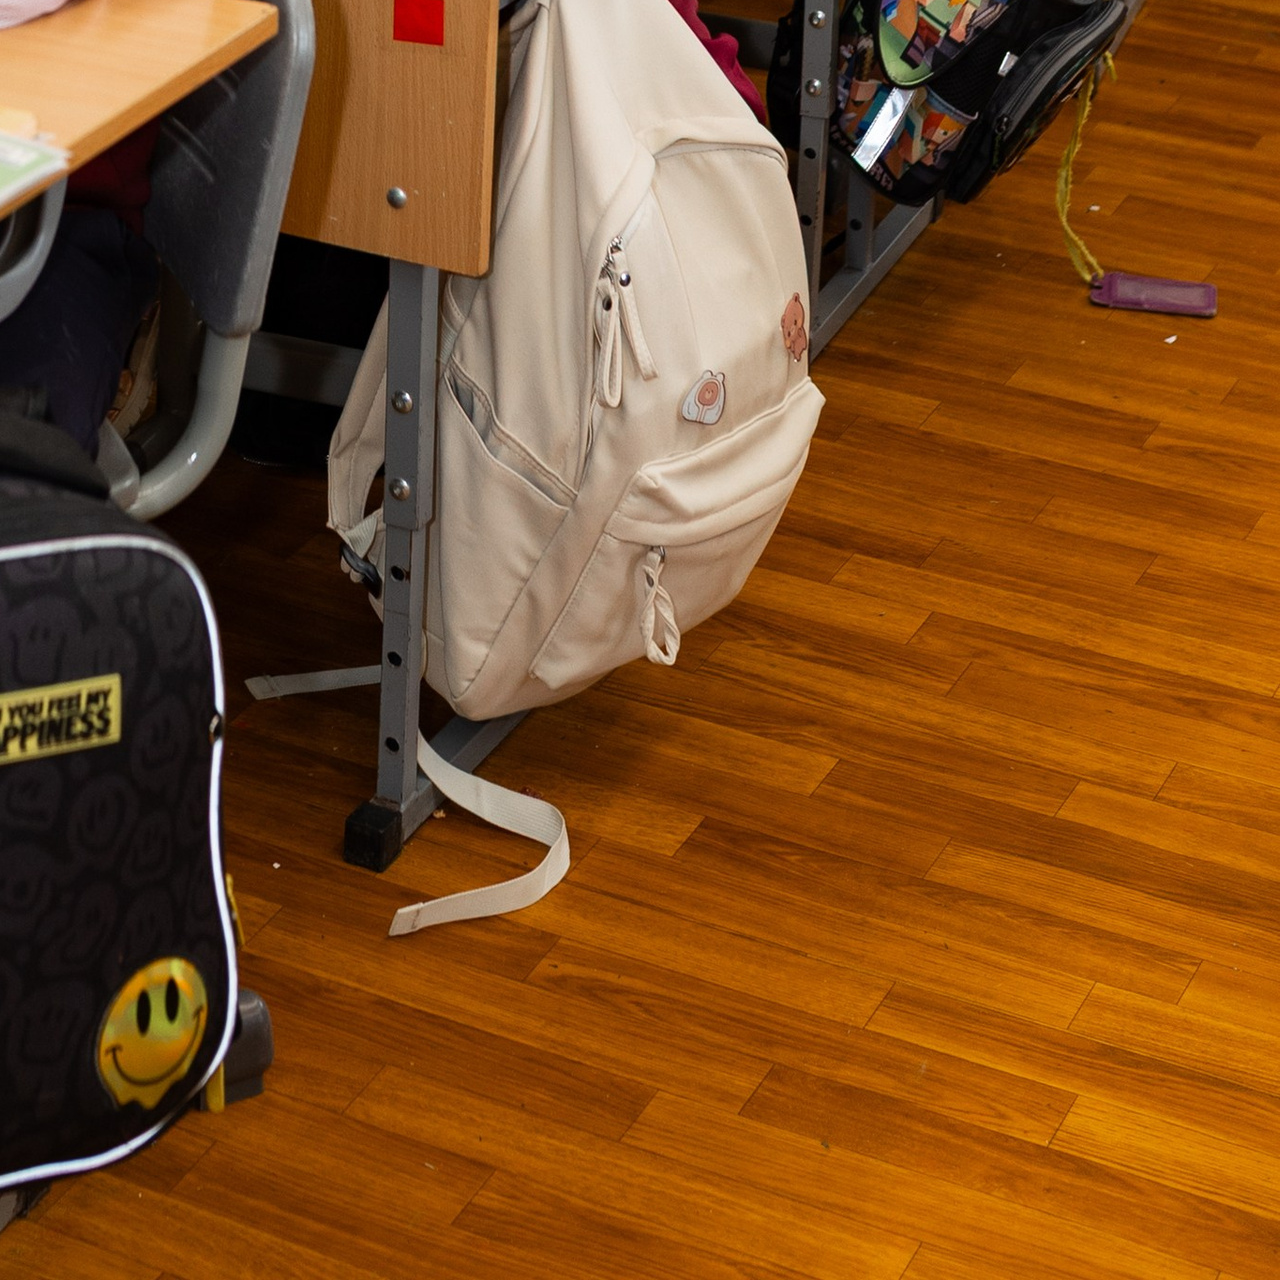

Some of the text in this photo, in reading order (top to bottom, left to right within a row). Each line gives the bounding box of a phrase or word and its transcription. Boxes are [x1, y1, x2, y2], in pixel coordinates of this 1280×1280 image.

[8, 699, 43, 720] YOU
[48, 693, 82, 715] FEEL
[86, 687, 112, 706] MY
